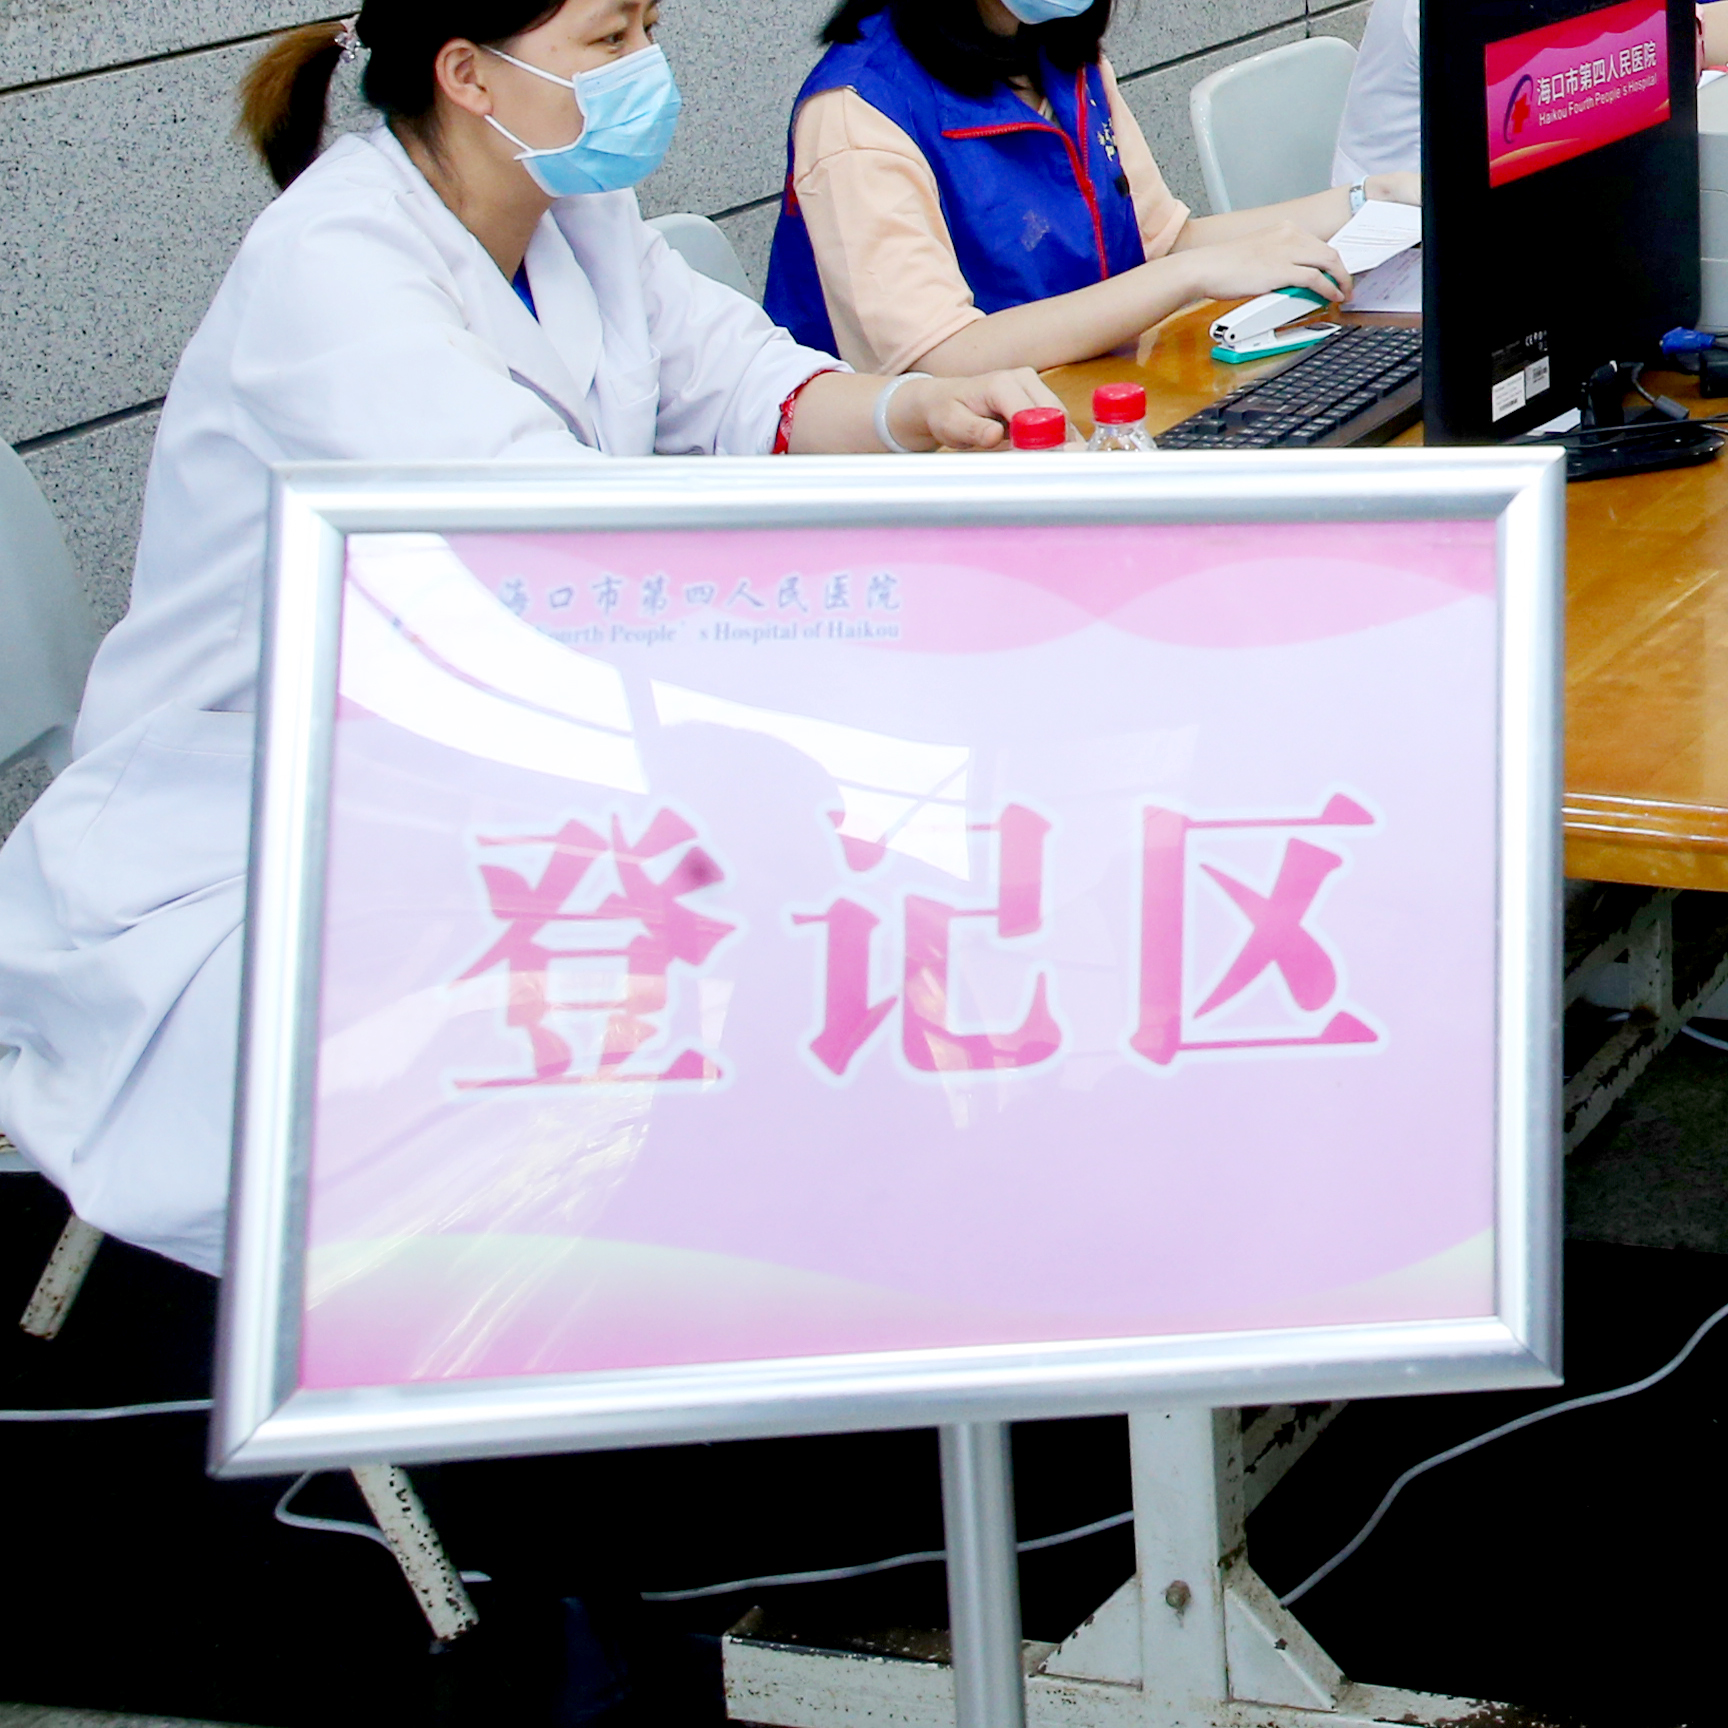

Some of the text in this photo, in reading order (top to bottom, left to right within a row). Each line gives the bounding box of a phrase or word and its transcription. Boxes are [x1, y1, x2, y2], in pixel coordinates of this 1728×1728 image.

[1537, 39, 1657, 106] 海口市第四人民医院
[1539, 108, 1568, 127] Haikou
[1568, 97, 1595, 116] Fourth
[1628, 72, 1658, 92] Hospital
[499, 573, 901, 617] 海口市第四人民医院
[714, 622, 798, 646] Hospital
[803, 622, 823, 640] of
[826, 621, 899, 640] Haikou
[448, 790, 1380, 1095] 登记区
